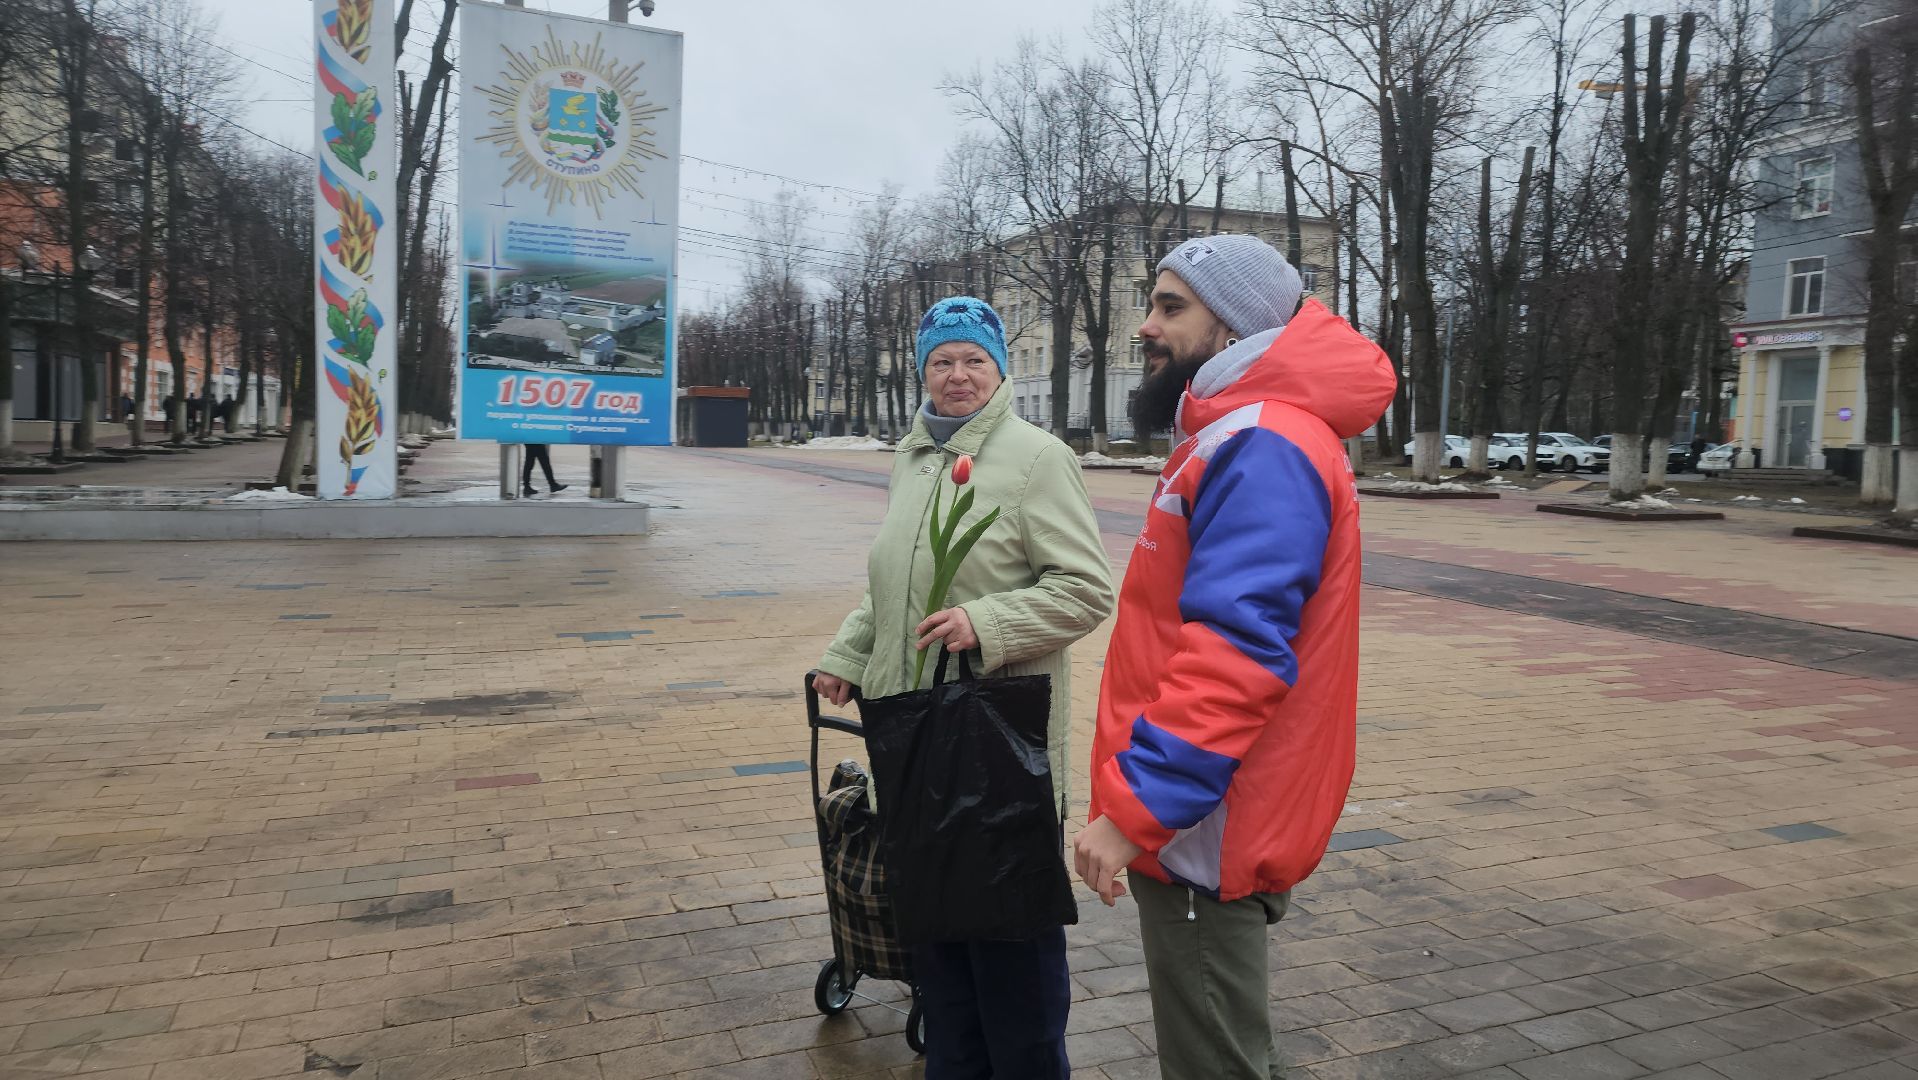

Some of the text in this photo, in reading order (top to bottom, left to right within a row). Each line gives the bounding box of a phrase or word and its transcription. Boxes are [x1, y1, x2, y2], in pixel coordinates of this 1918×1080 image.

[546, 159, 600, 175] СТУПИНО
[499, 376, 641, 413] 1507 год
